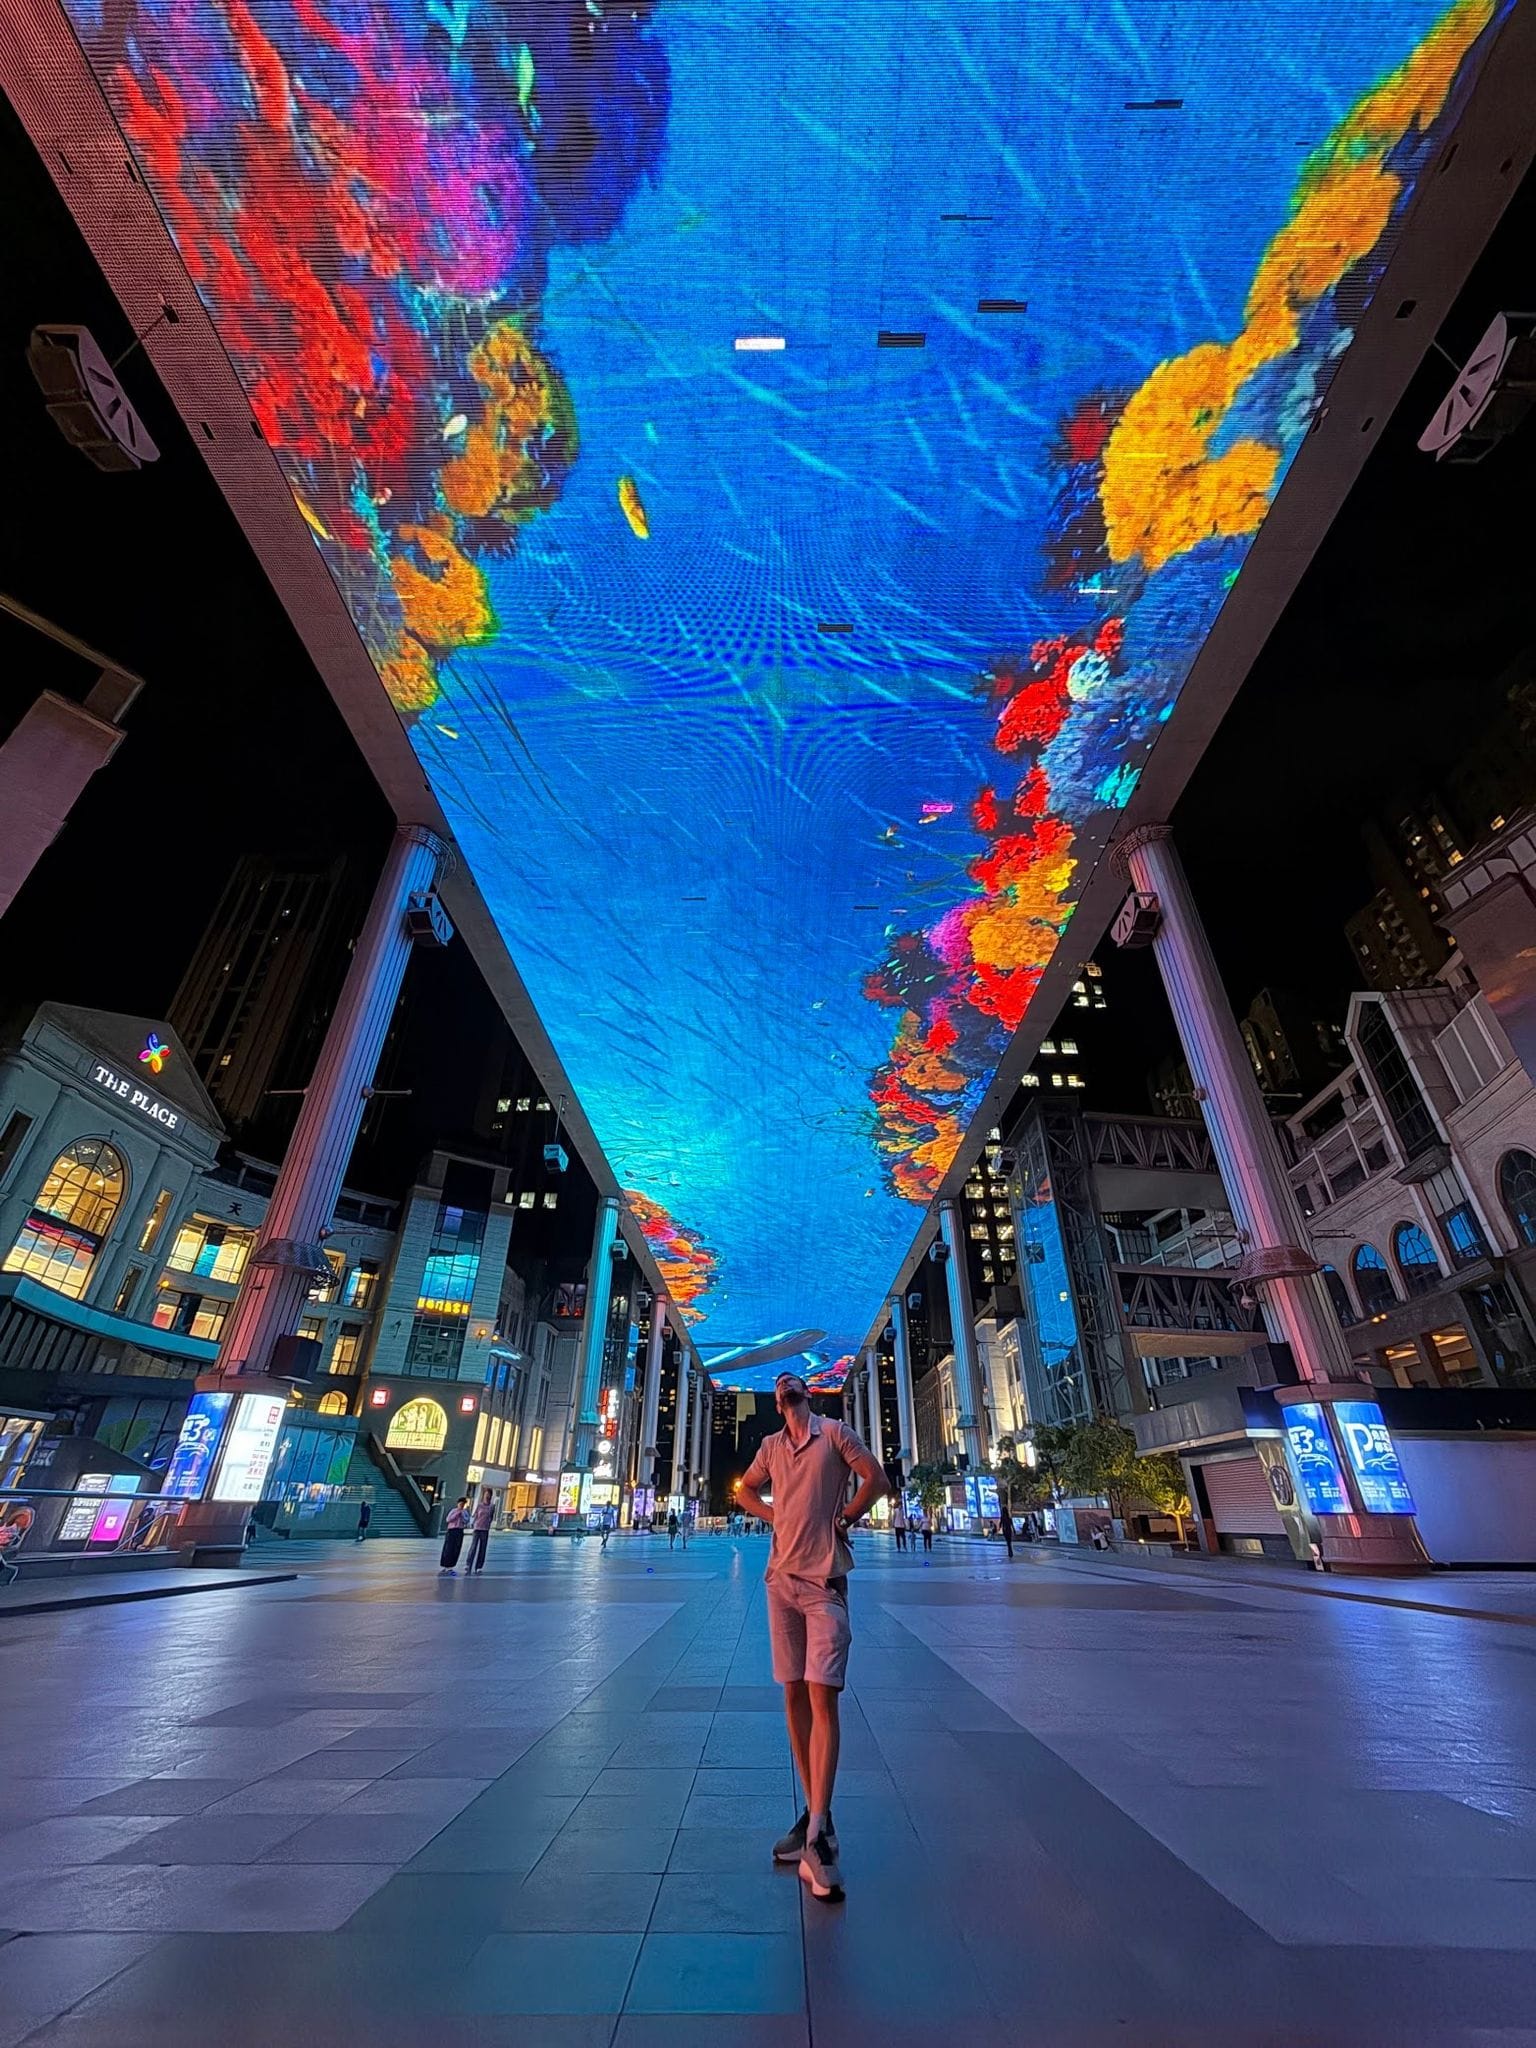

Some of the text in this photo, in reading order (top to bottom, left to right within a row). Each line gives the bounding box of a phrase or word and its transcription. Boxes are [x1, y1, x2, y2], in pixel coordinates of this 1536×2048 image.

[95, 1067, 178, 1129] THE PLACE
[1345, 1423, 1373, 1470] P
